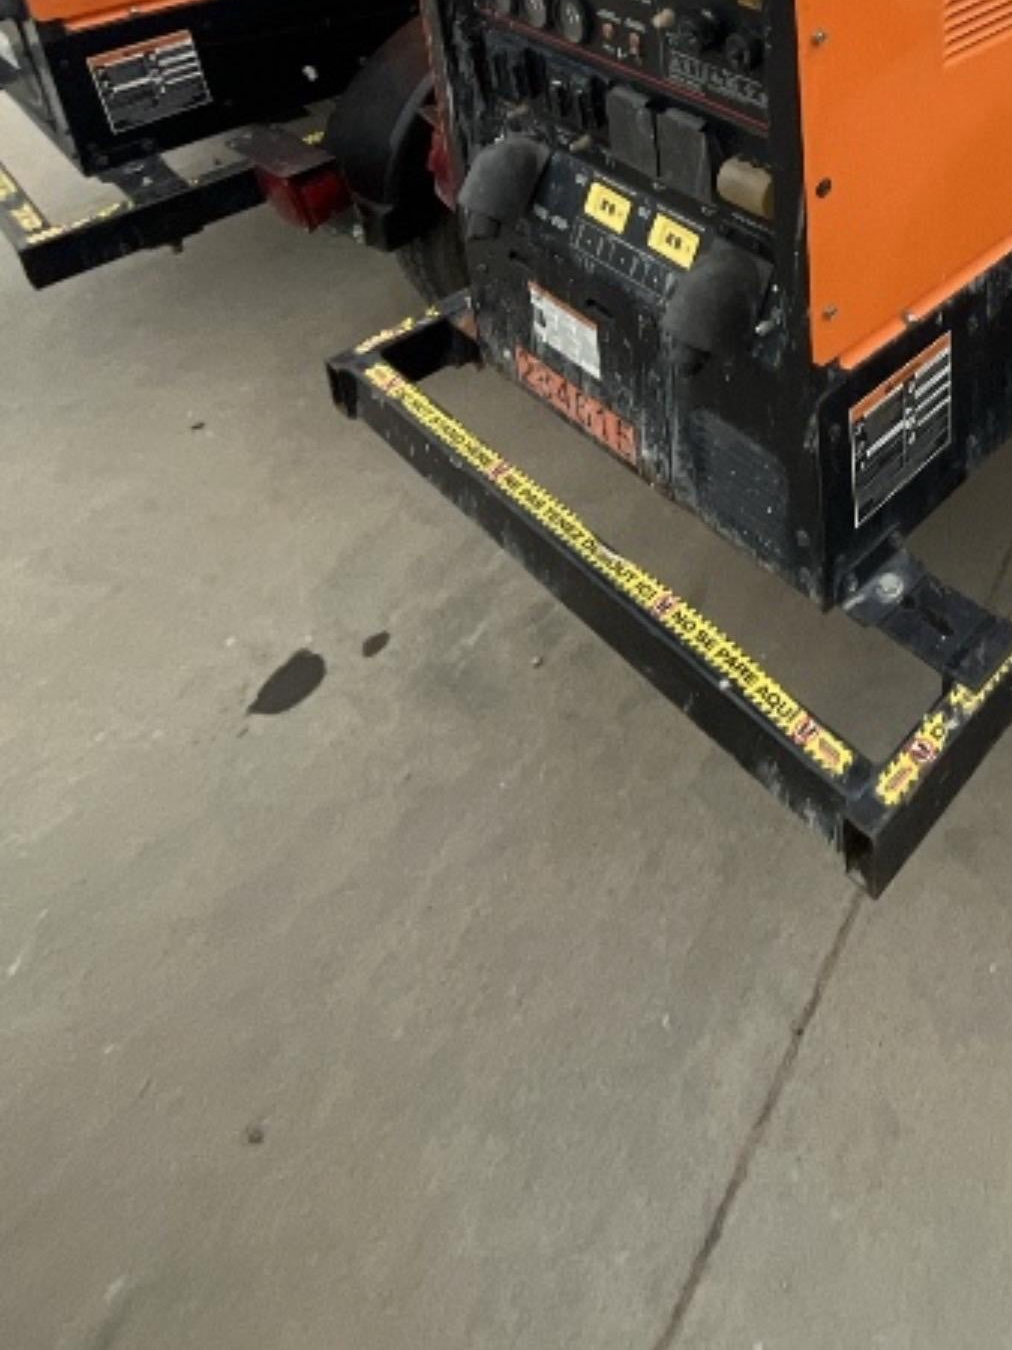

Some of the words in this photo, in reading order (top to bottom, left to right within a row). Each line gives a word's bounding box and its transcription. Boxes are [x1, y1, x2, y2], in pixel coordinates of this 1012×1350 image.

[670, 610, 697, 632] NO
[697, 629, 714, 651] SE
[713, 647, 760, 685] PARE
